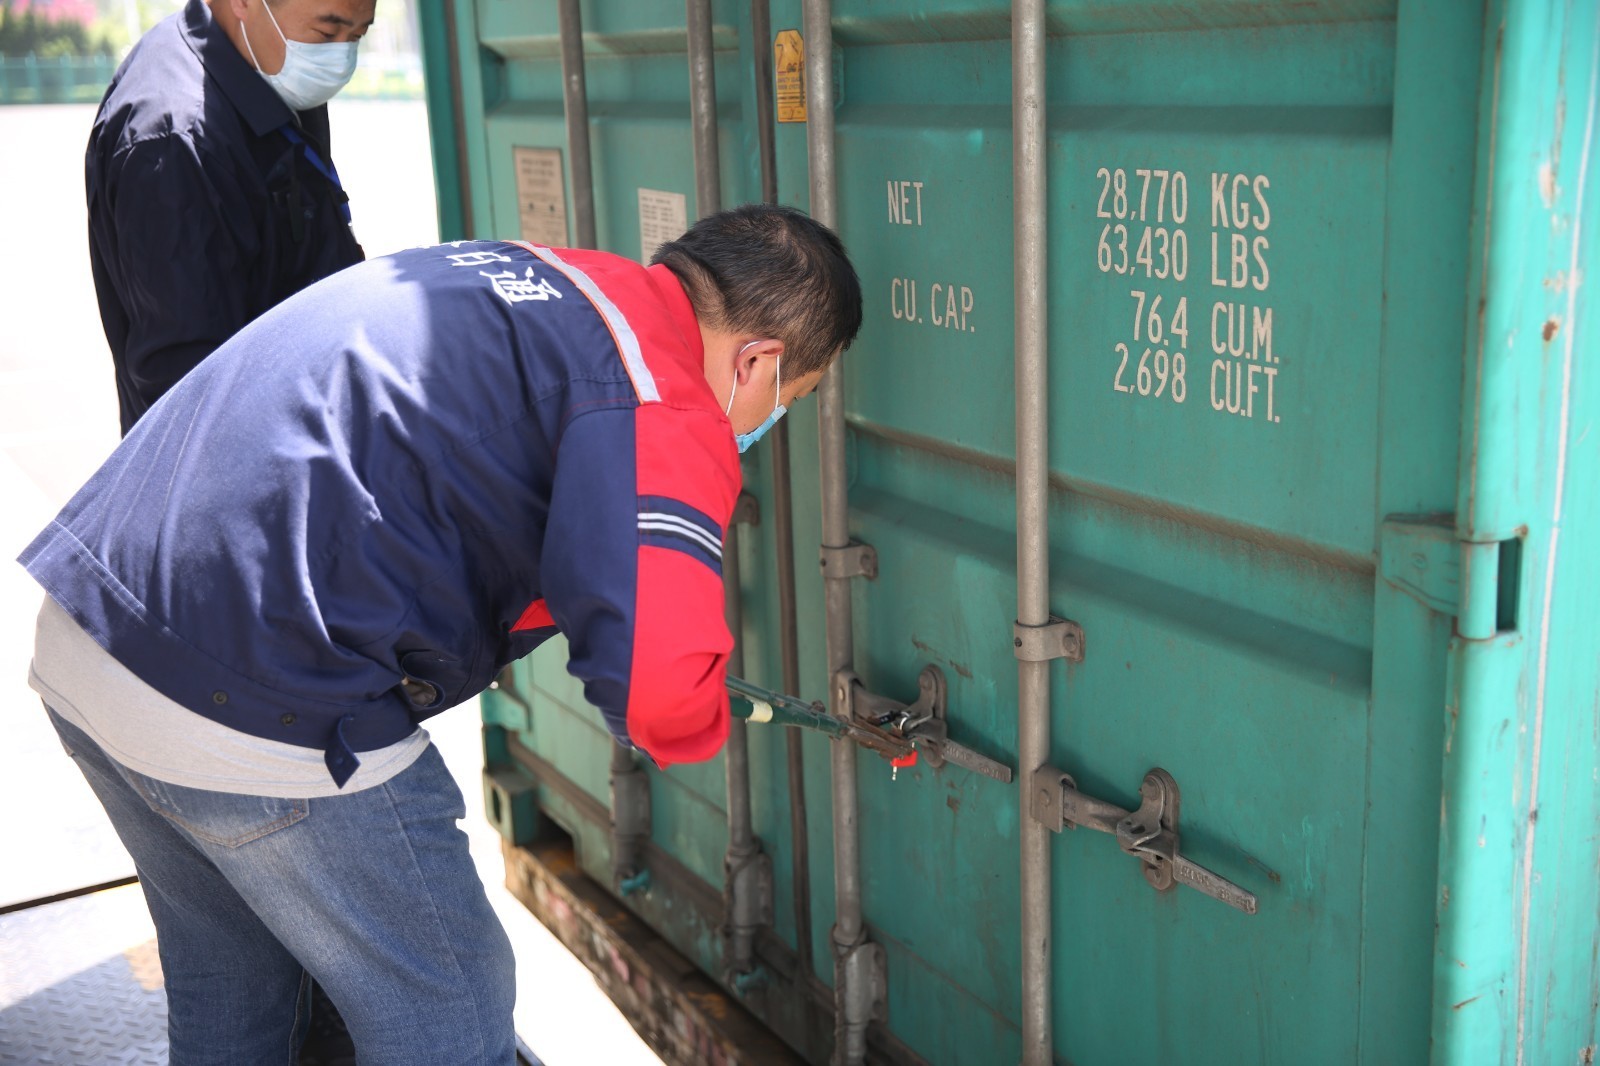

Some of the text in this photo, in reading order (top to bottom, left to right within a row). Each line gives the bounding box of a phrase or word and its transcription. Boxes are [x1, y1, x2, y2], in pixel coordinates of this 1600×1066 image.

[887, 167, 1271, 231] NET 28,770 KGS
[1097, 223, 1271, 291] 63,430 LBS
[891, 278, 923, 325] CU.
[930, 283, 976, 333] CAP.
[1130, 290, 1189, 349] 76.4
[1113, 342, 1187, 404] 2,698
